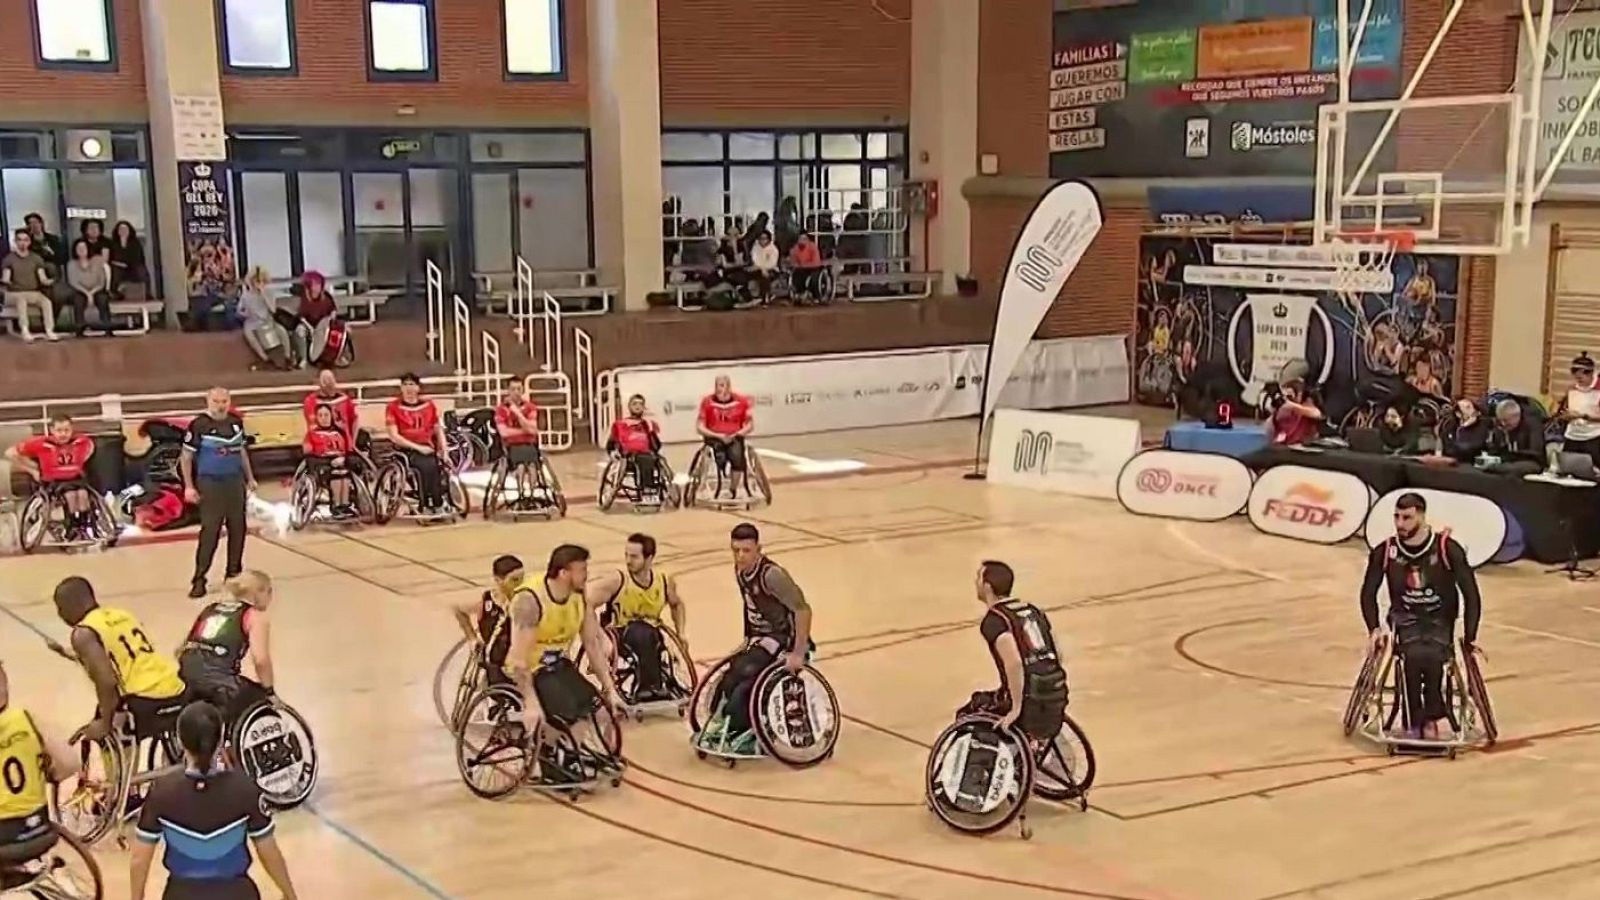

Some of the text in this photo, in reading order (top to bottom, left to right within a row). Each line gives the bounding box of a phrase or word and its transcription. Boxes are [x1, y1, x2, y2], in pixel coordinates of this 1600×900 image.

[1054, 44, 1109, 66] FAMILIAS
[1054, 64, 1119, 85] QUEREMOS
[1055, 87, 1121, 106] JUGAR CON
[1055, 111, 1091, 126] ESTAS
[1054, 131, 1098, 146] REGLAS
[1252, 126, 1315, 144] Móstoles
[191, 179, 217, 193] COPA
[186, 192, 224, 203] DEL REY
[1219, 403, 1230, 425] 9
[1174, 482, 1217, 498] ONCE
[118, 627, 154, 659] 13
